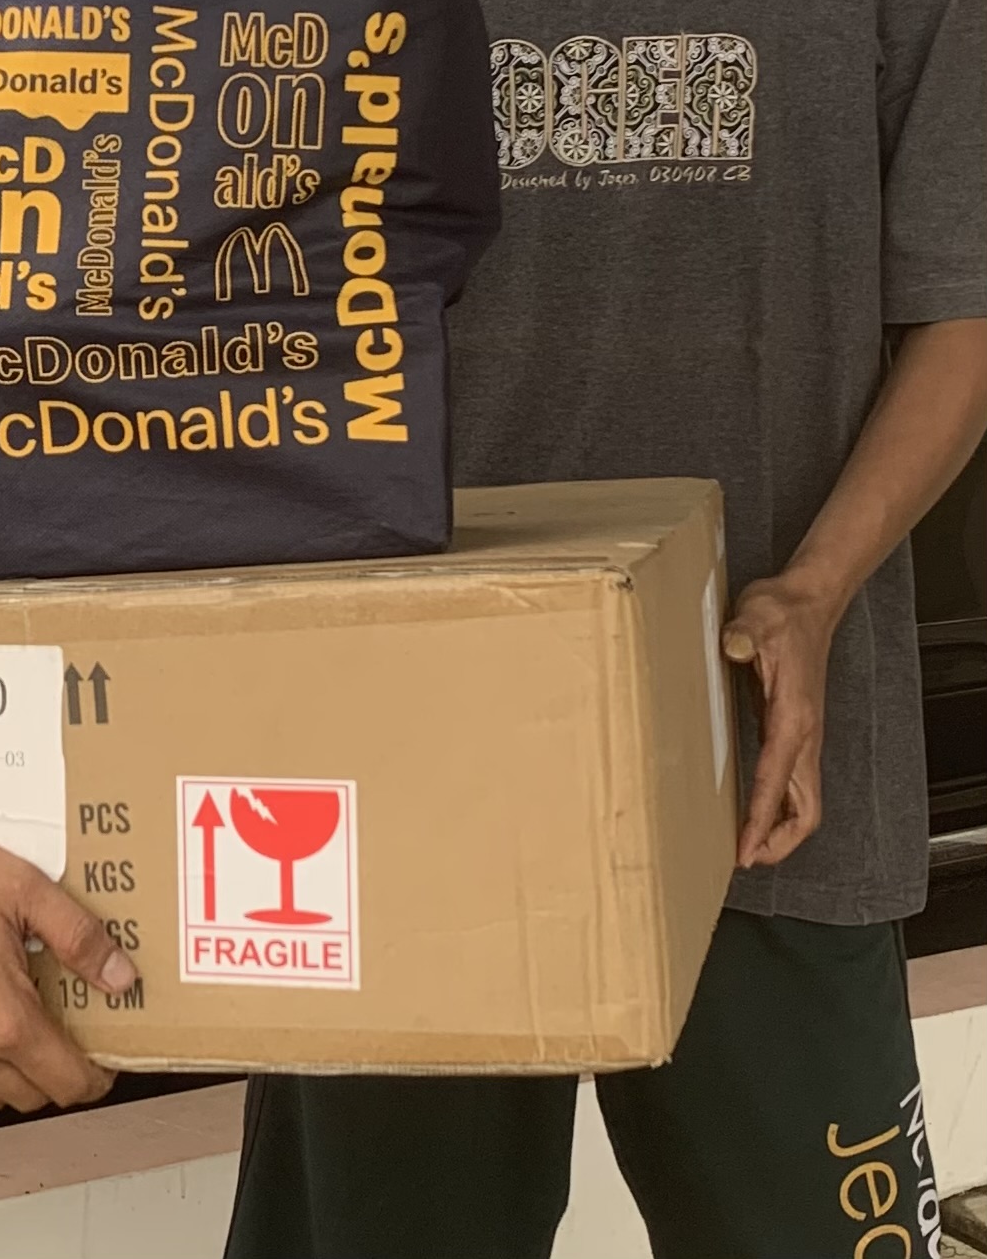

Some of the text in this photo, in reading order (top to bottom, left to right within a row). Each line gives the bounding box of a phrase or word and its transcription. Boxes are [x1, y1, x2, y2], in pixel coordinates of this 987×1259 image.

[219, 12, 329, 69] McD
[217, 72, 326, 150] on
[139, 5, 198, 321] McDonald's
[213, 153, 321, 209] ald's
[500, 171, 568, 190] Designed
[574, 169, 592, 190] by
[74, 133, 122, 317] McDonald's
[336, 11, 409, 443] McDonald's
[79, 803, 131, 834] PCS
[84, 861, 136, 893] KGS
[101, 919, 140, 952] GS
[193, 936, 343, 971] FRAGILE
[60, 979, 89, 1009] 19
